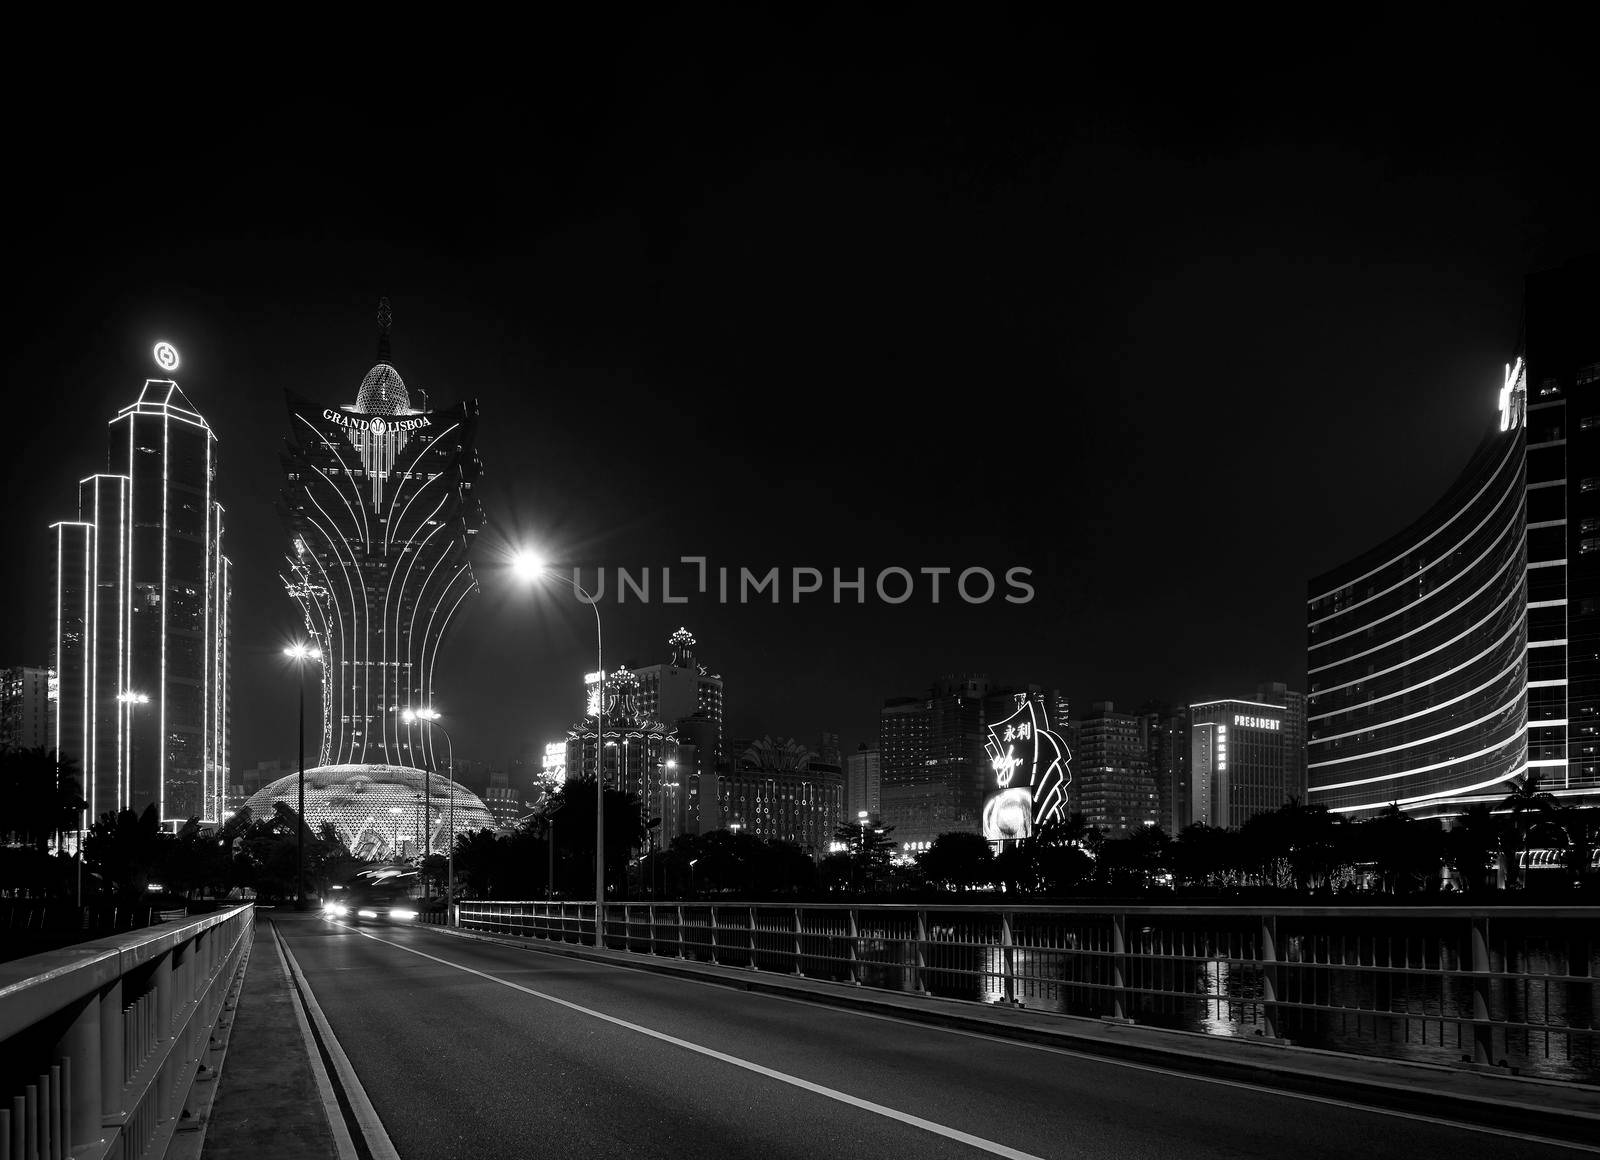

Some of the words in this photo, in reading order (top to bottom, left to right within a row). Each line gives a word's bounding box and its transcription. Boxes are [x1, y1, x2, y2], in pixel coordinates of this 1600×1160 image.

[322, 408, 370, 431] GRAND
[386, 416, 432, 432] LISBOA
[1003, 721, 1031, 742] 永利
[1234, 715, 1280, 730] PRESIDENT
